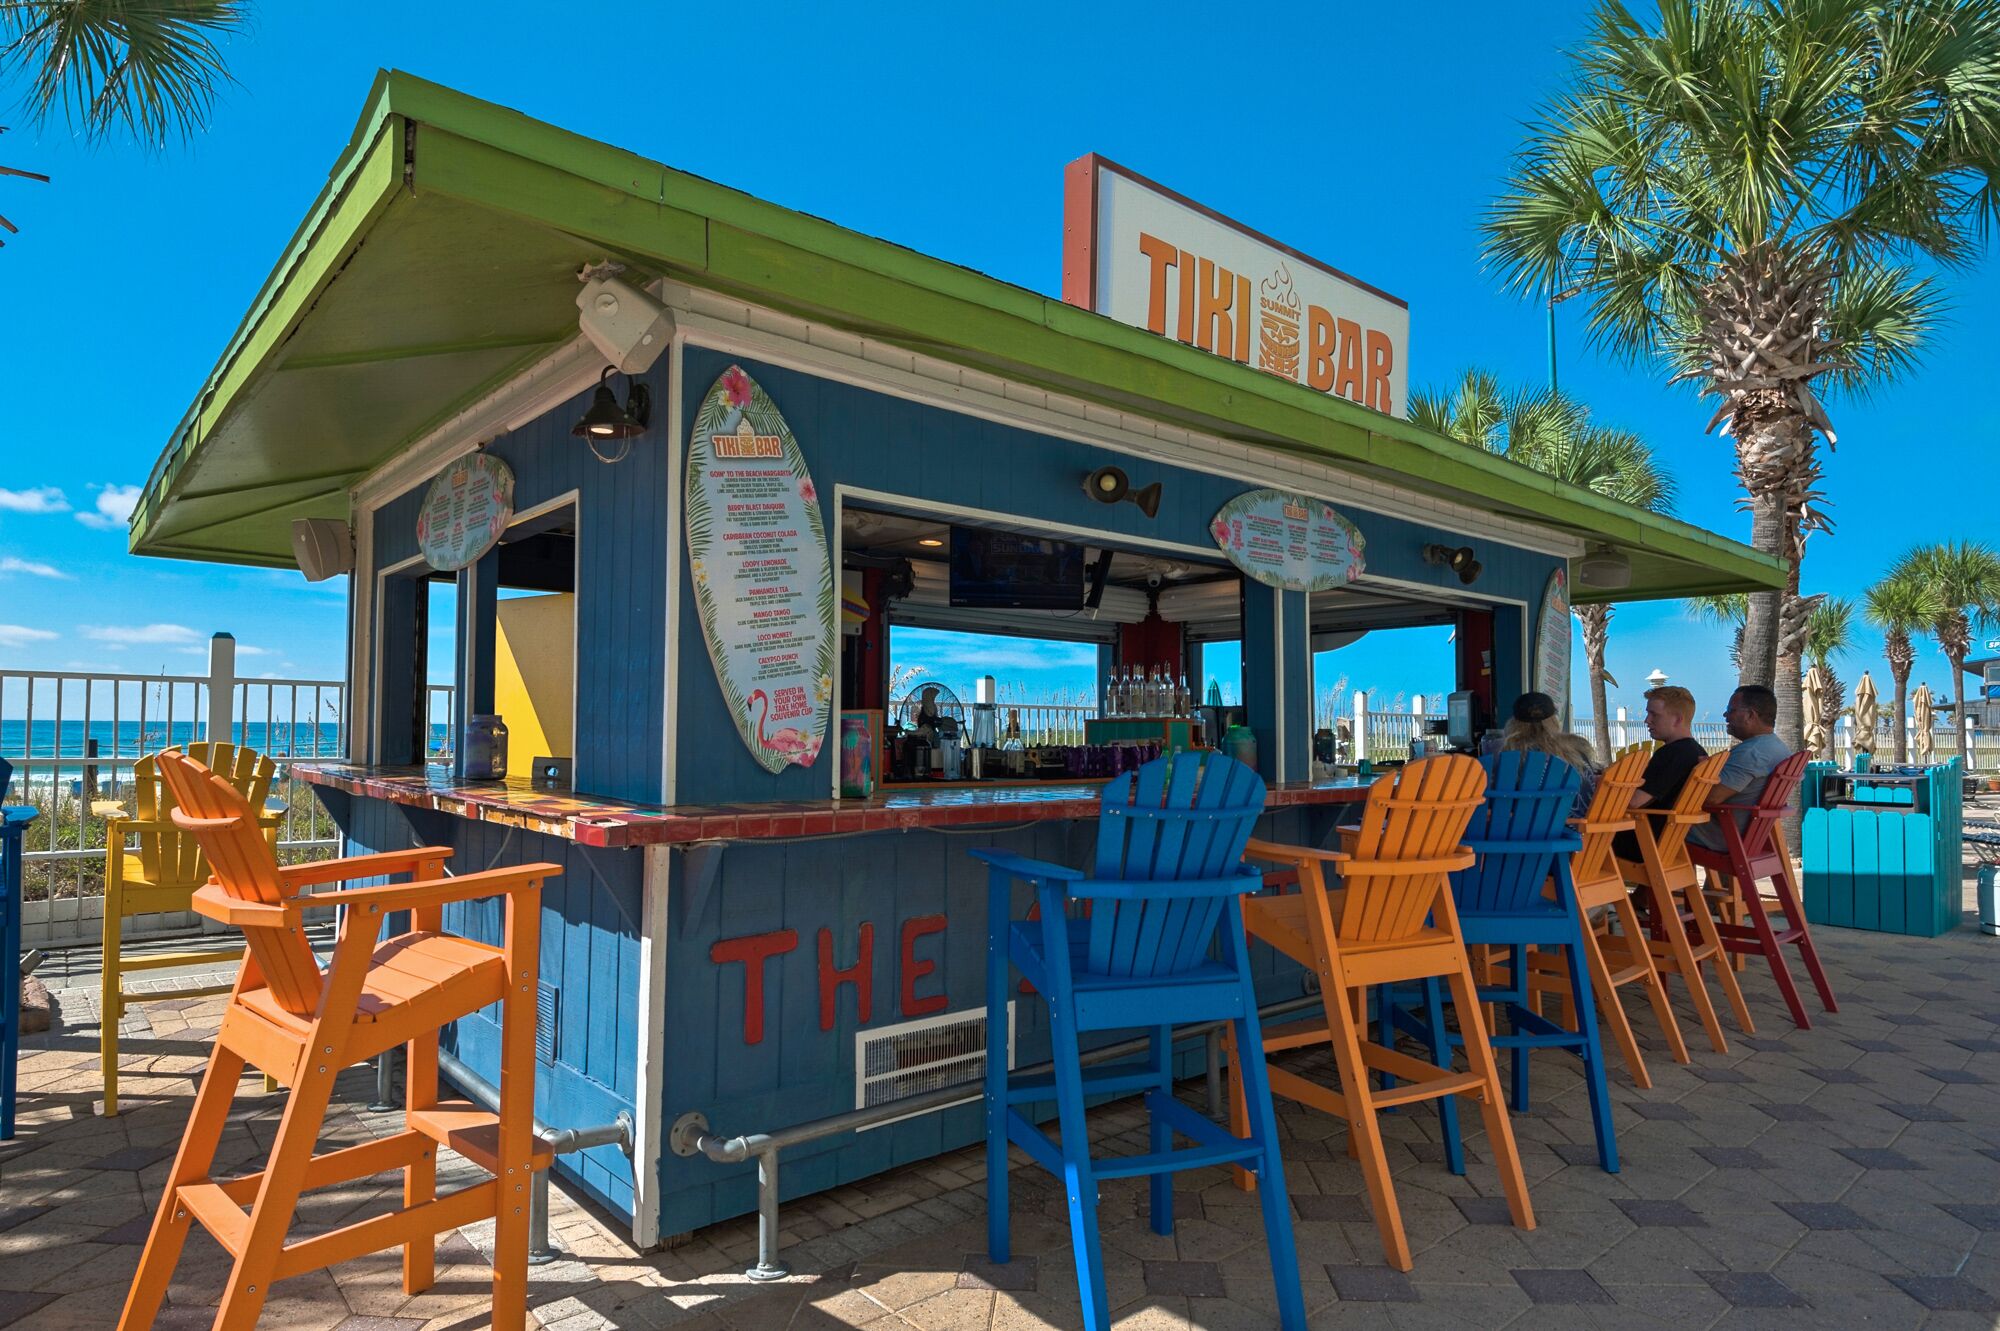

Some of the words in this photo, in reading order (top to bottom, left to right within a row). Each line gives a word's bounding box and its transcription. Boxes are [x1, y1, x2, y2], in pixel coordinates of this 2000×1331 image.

[1260, 296, 1301, 322] SUMMIT
[1139, 231, 1252, 365] TIKI
[1308, 304, 1393, 417] BAR
[713, 436, 740, 456] TIKI
[755, 436, 782, 456] BAR
[761, 558, 787, 566] LEMONADE
[749, 586, 778, 596] PANHANDLE
[771, 631, 792, 639] MONKEY
[758, 655, 781, 664] CALYPSO
[781, 653, 799, 661] PUNCH
[774, 688, 796, 697] SERVED
[774, 696, 790, 705] YOUR
[792, 694, 806, 702] OWN
[774, 704, 790, 712] TAKE
[790, 701, 808, 710] HOME
[770, 710, 800, 722] SOUVENIR
[801, 706, 812, 716] CUP
[710, 914, 948, 1045] THE
